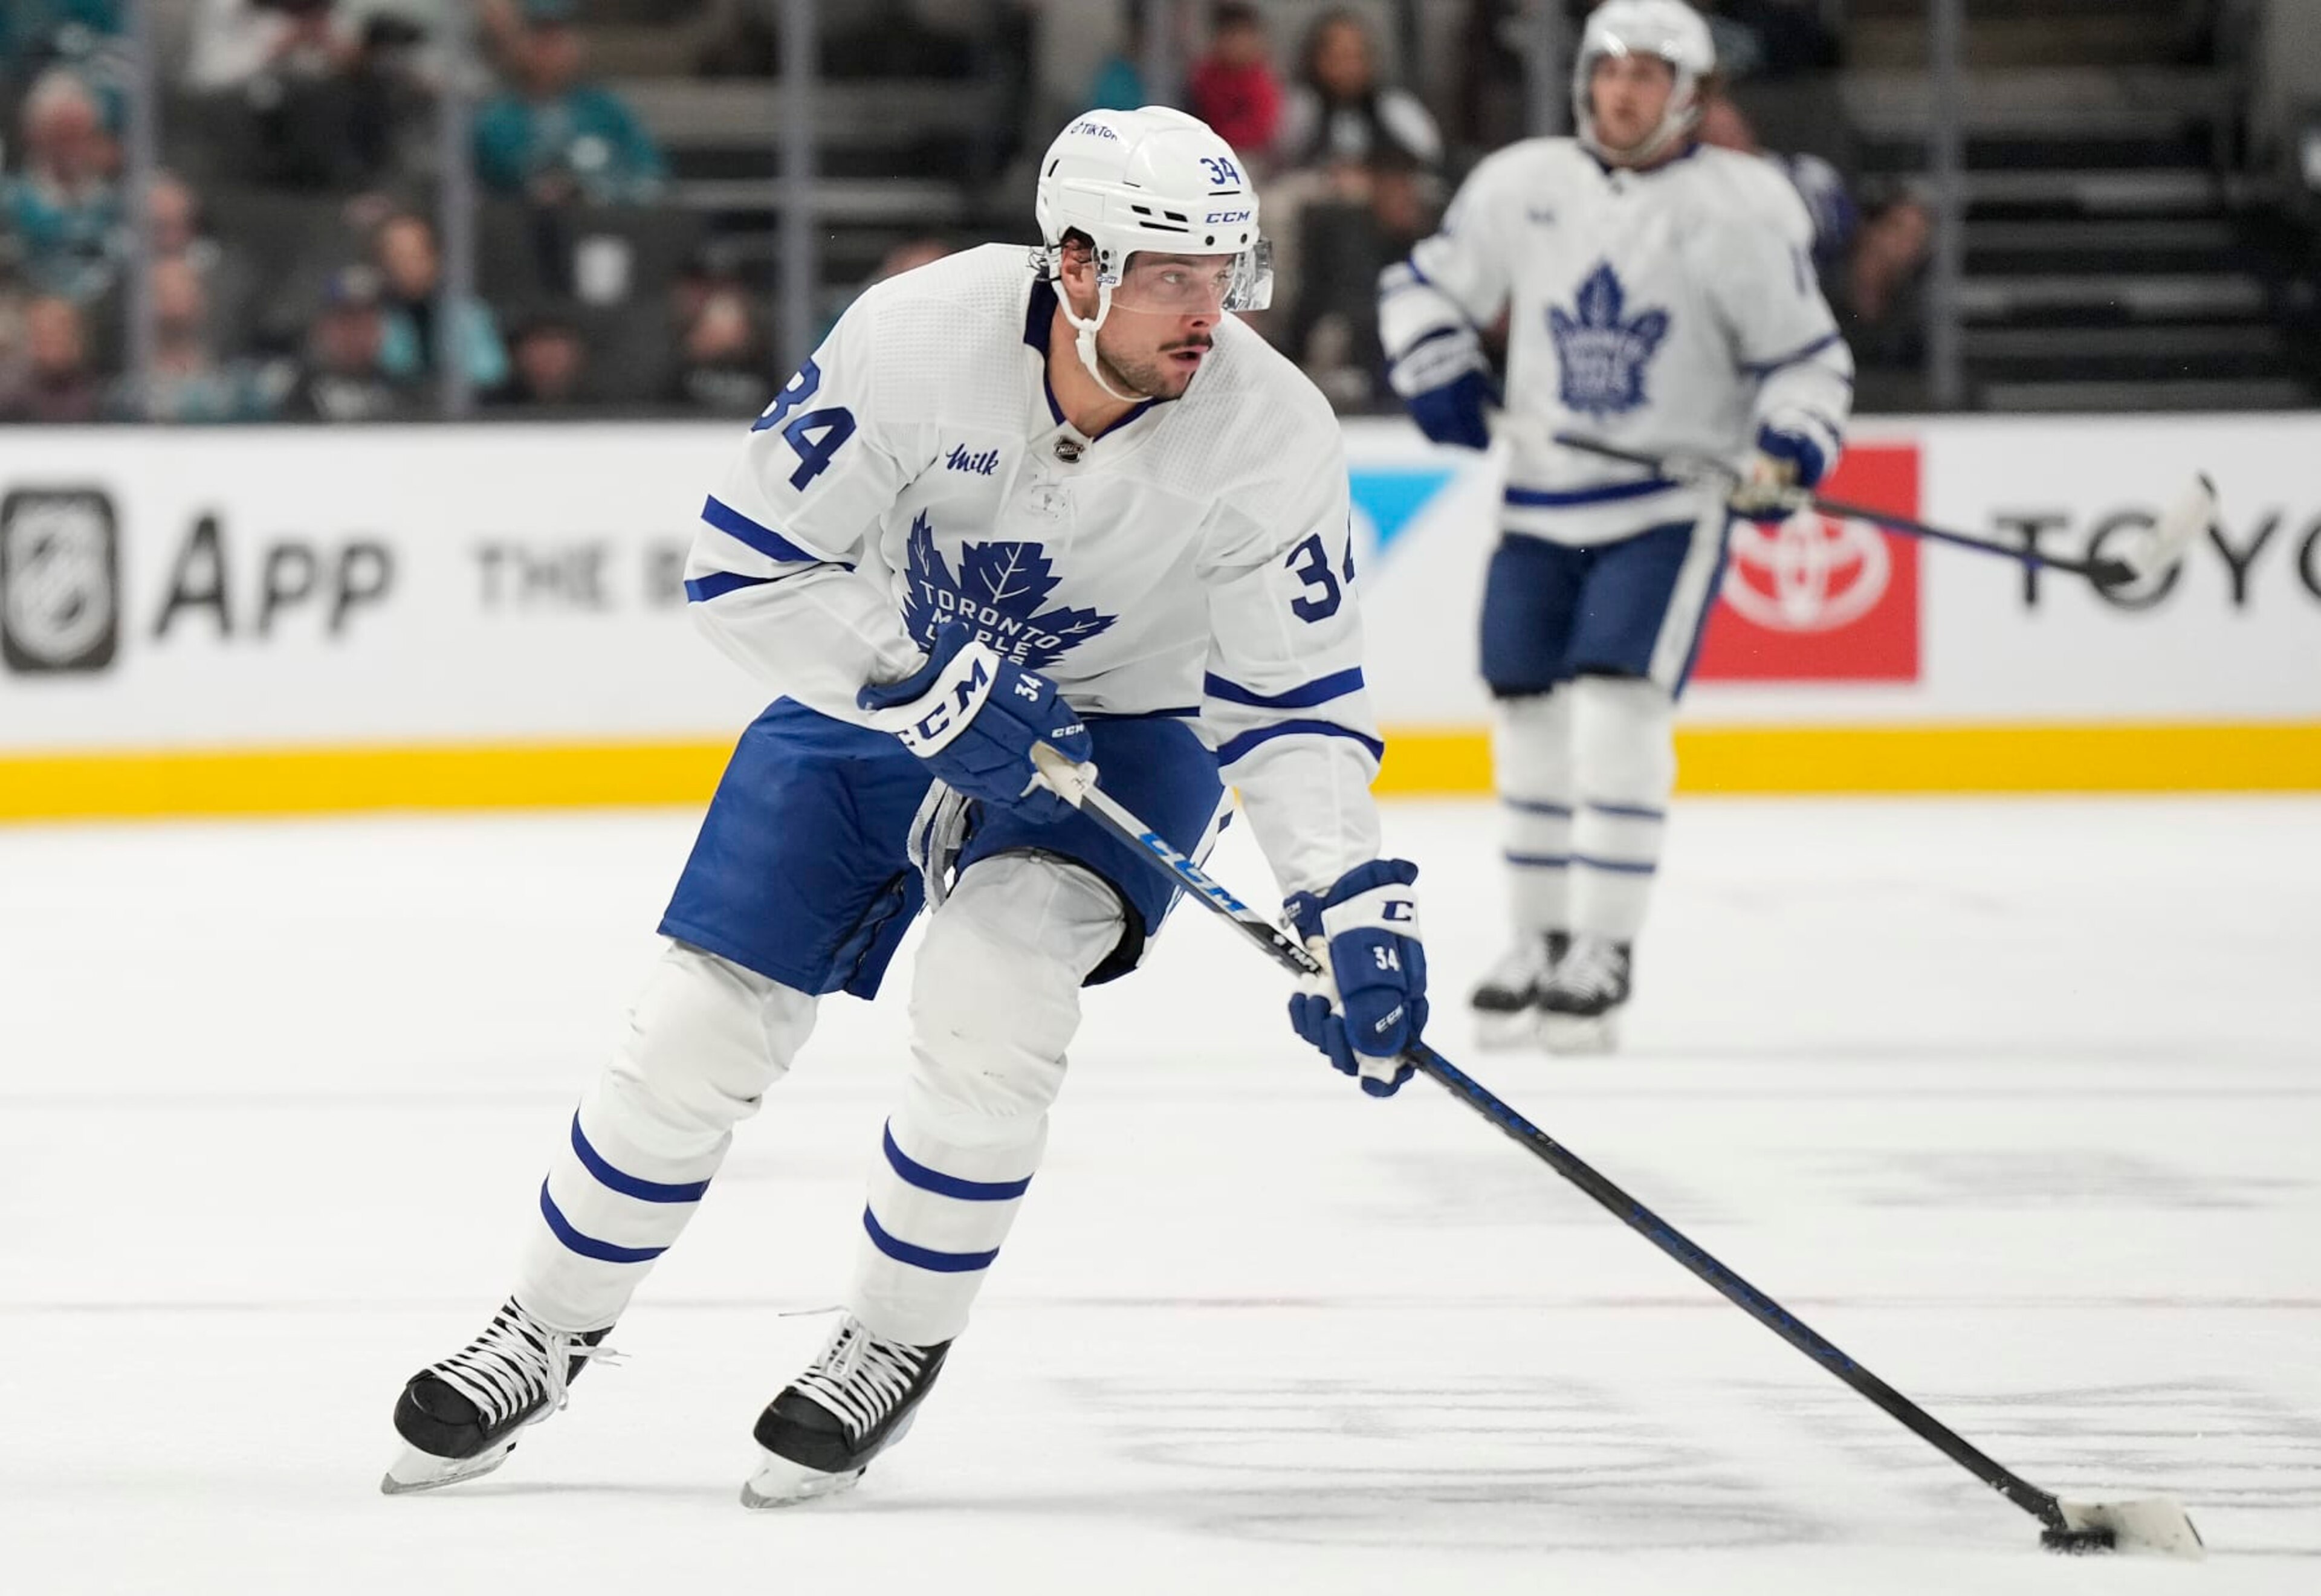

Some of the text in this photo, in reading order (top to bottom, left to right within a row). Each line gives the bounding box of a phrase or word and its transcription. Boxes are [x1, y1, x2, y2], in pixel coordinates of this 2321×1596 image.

[1200, 158, 1240, 185] 34
[1206, 211, 1251, 224] CCM
[946, 443, 999, 476] Milk
[151, 512, 397, 638] App
[919, 580, 1062, 649] TORONTO
[931, 609, 1032, 656] MPLE
[896, 657, 989, 746] CM
[1014, 673, 1043, 702] 34
[1051, 723, 1084, 738] CCM
[1372, 946, 1400, 971] 34
[1374, 1005, 1404, 1033] CCM
